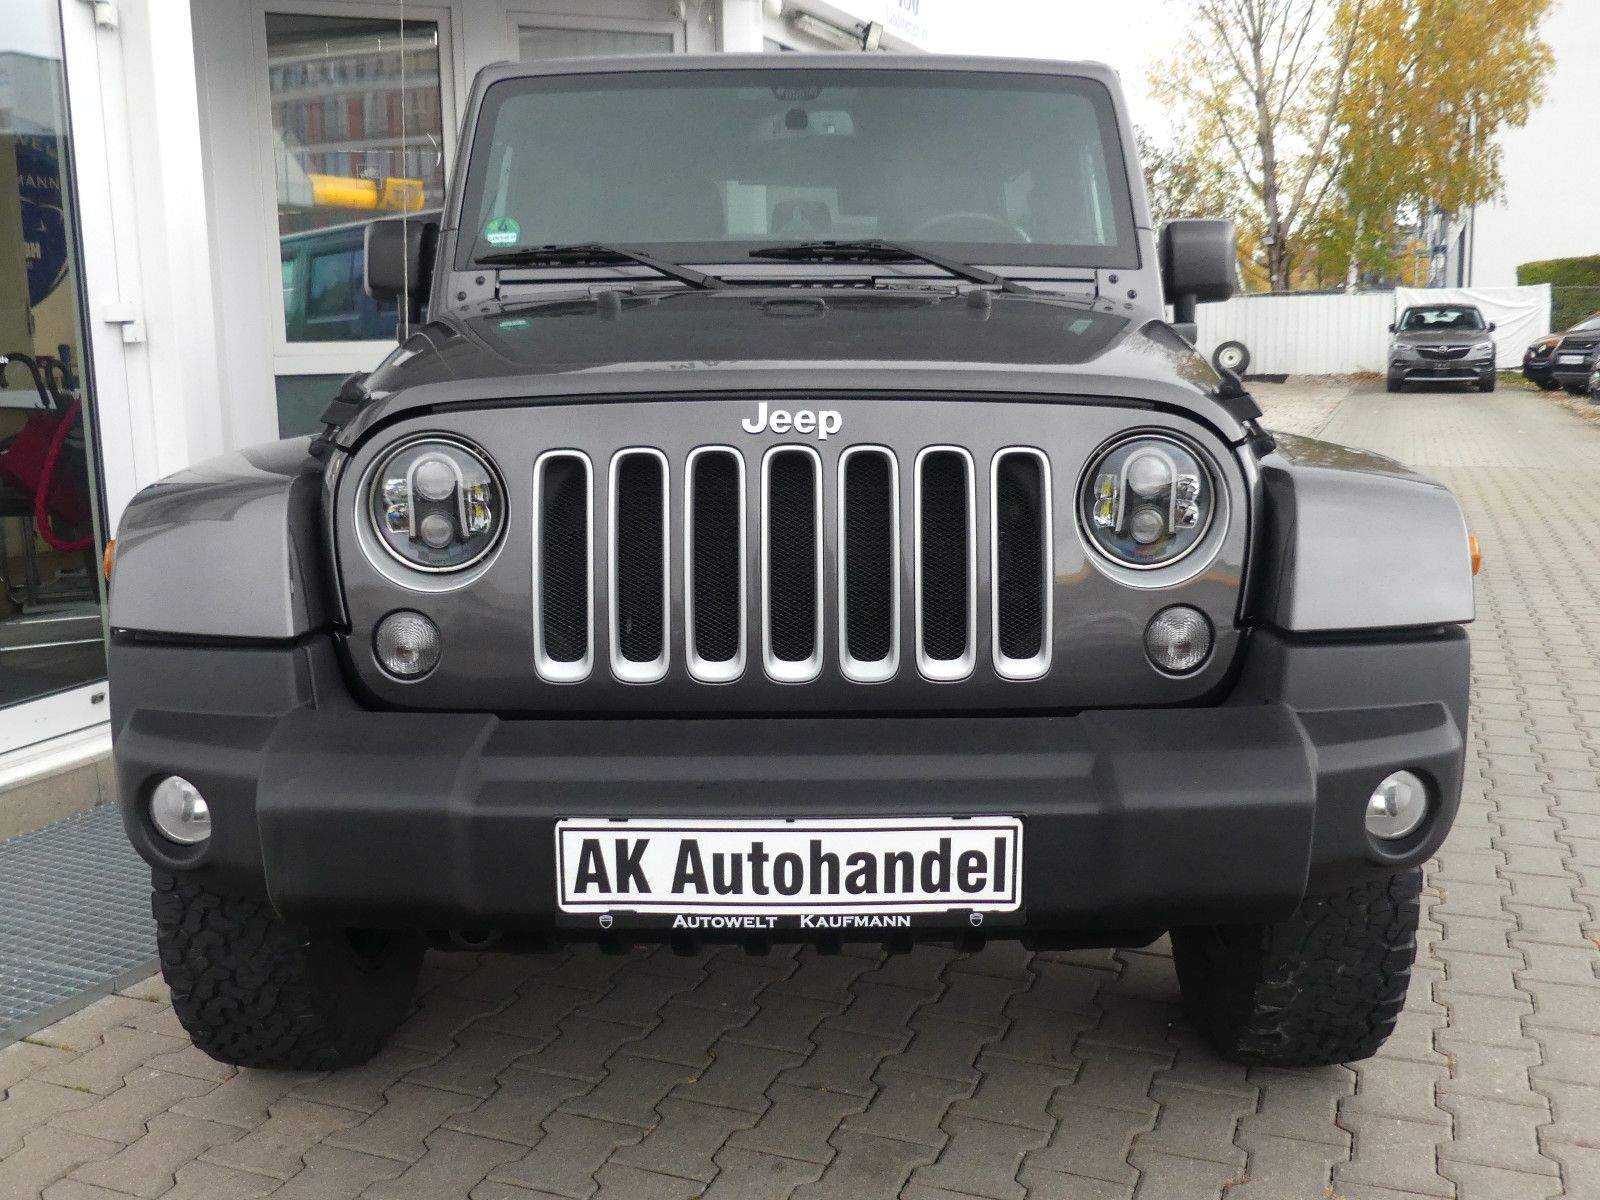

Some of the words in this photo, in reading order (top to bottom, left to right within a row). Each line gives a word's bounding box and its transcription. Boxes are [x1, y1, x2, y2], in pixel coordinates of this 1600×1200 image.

[741, 401, 843, 440] Jeep
[573, 838, 652, 894] AK
[671, 837, 1007, 895] Autohandel
[672, 914, 778, 929] AUTOWELT
[800, 914, 911, 928] KAUFMANN
